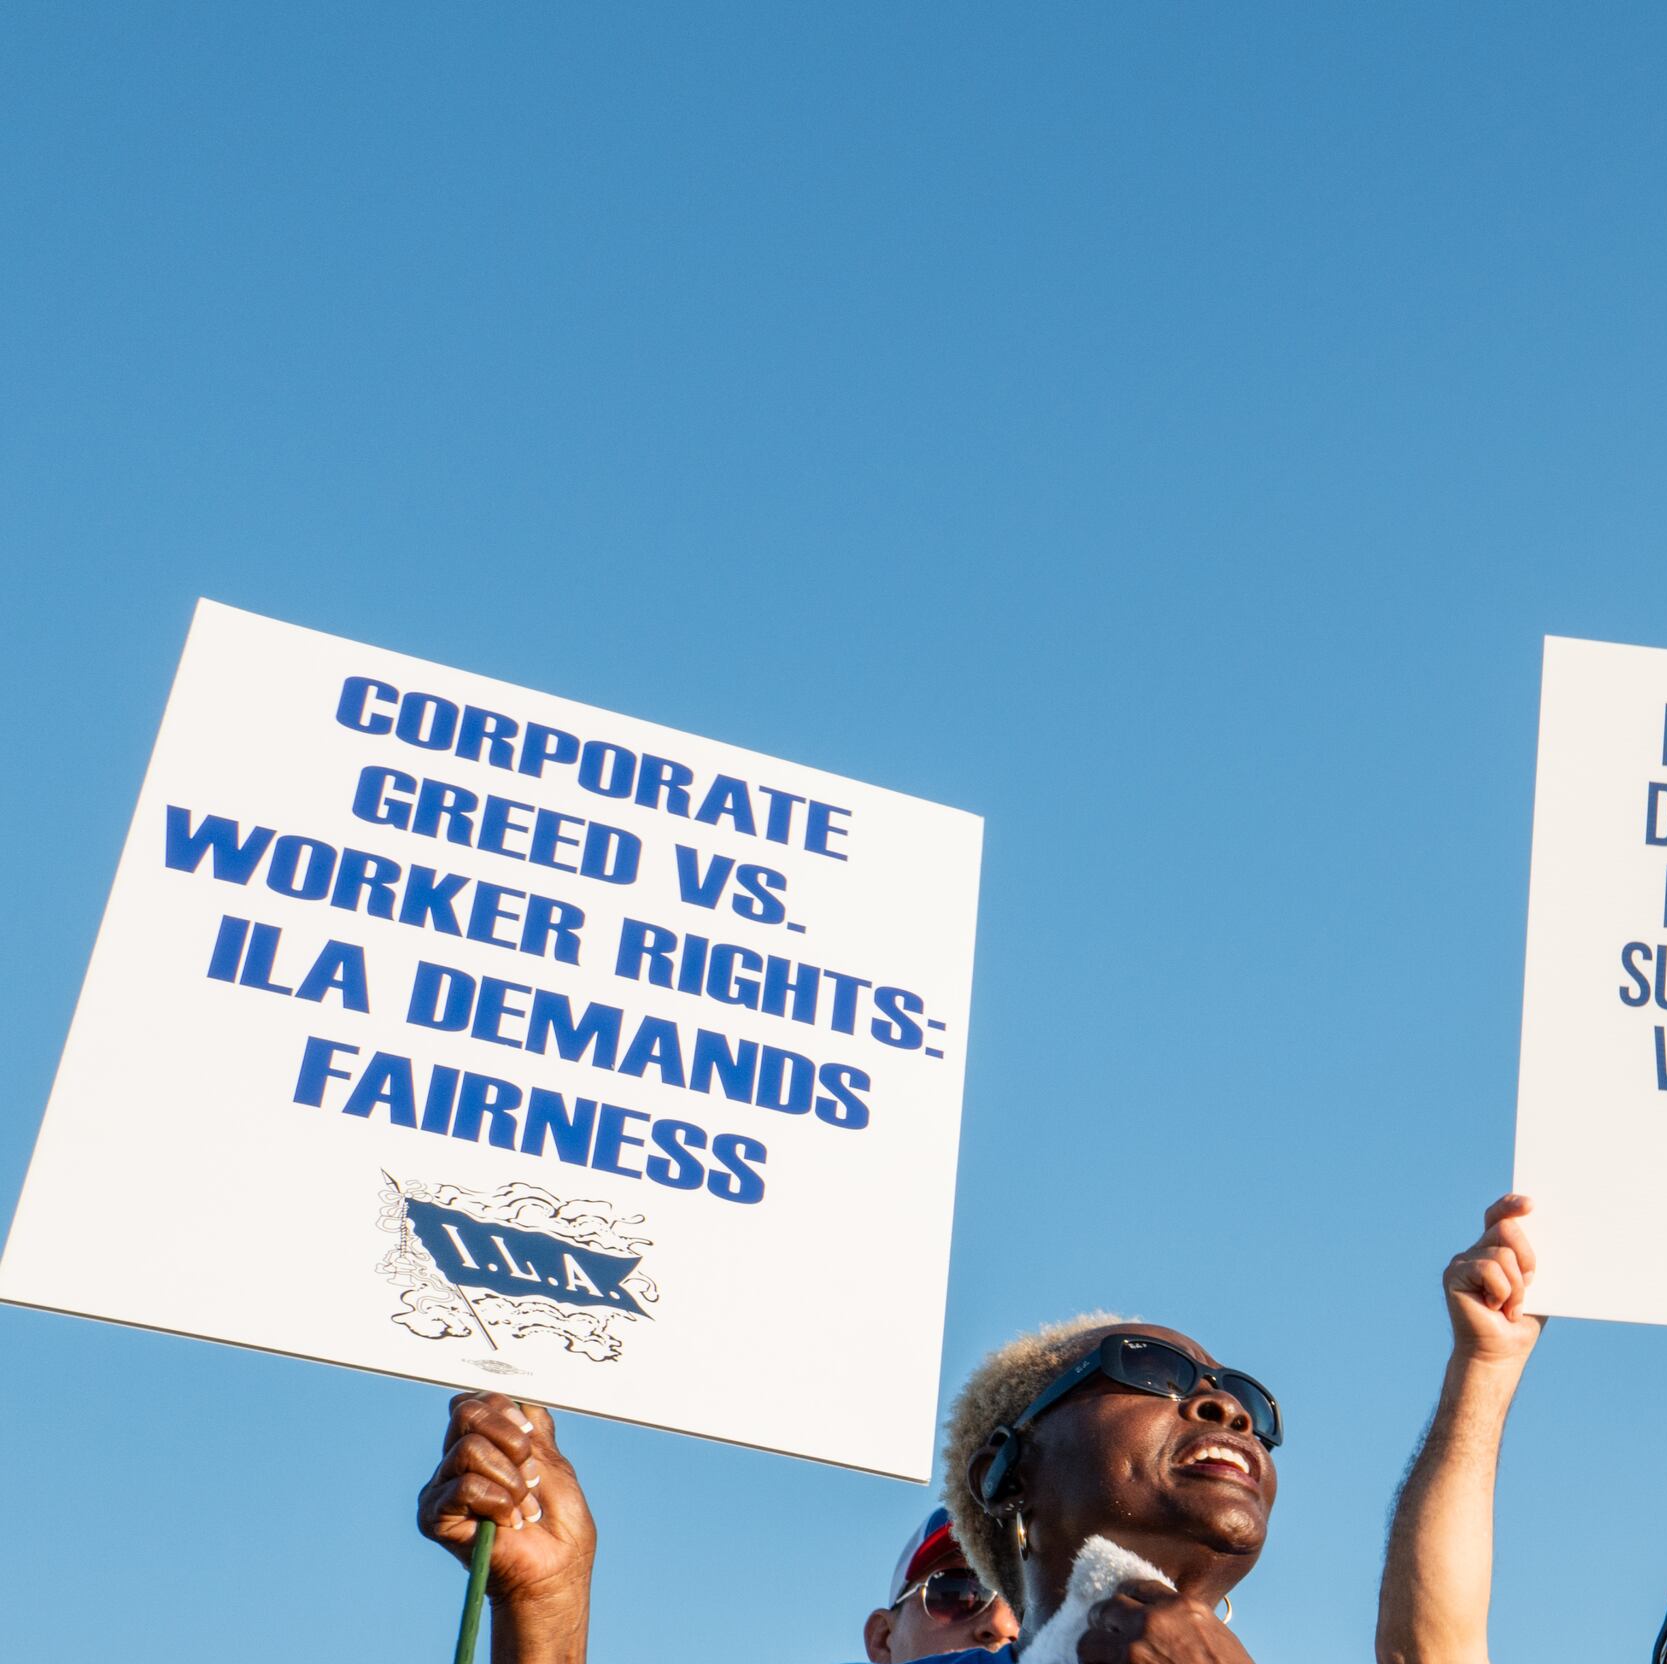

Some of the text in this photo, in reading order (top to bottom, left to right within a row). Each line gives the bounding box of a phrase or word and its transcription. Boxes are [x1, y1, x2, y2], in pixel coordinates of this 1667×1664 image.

[336, 675, 853, 861] CORPORATE
[352, 766, 807, 934] GREED VS.
[164, 805, 948, 1060] WORKER RIGHTS:
[207, 916, 870, 1131] ILA DEMANDS
[292, 1035, 768, 1205] FAIRNESS
[440, 1222, 623, 1300] I.L.A.
